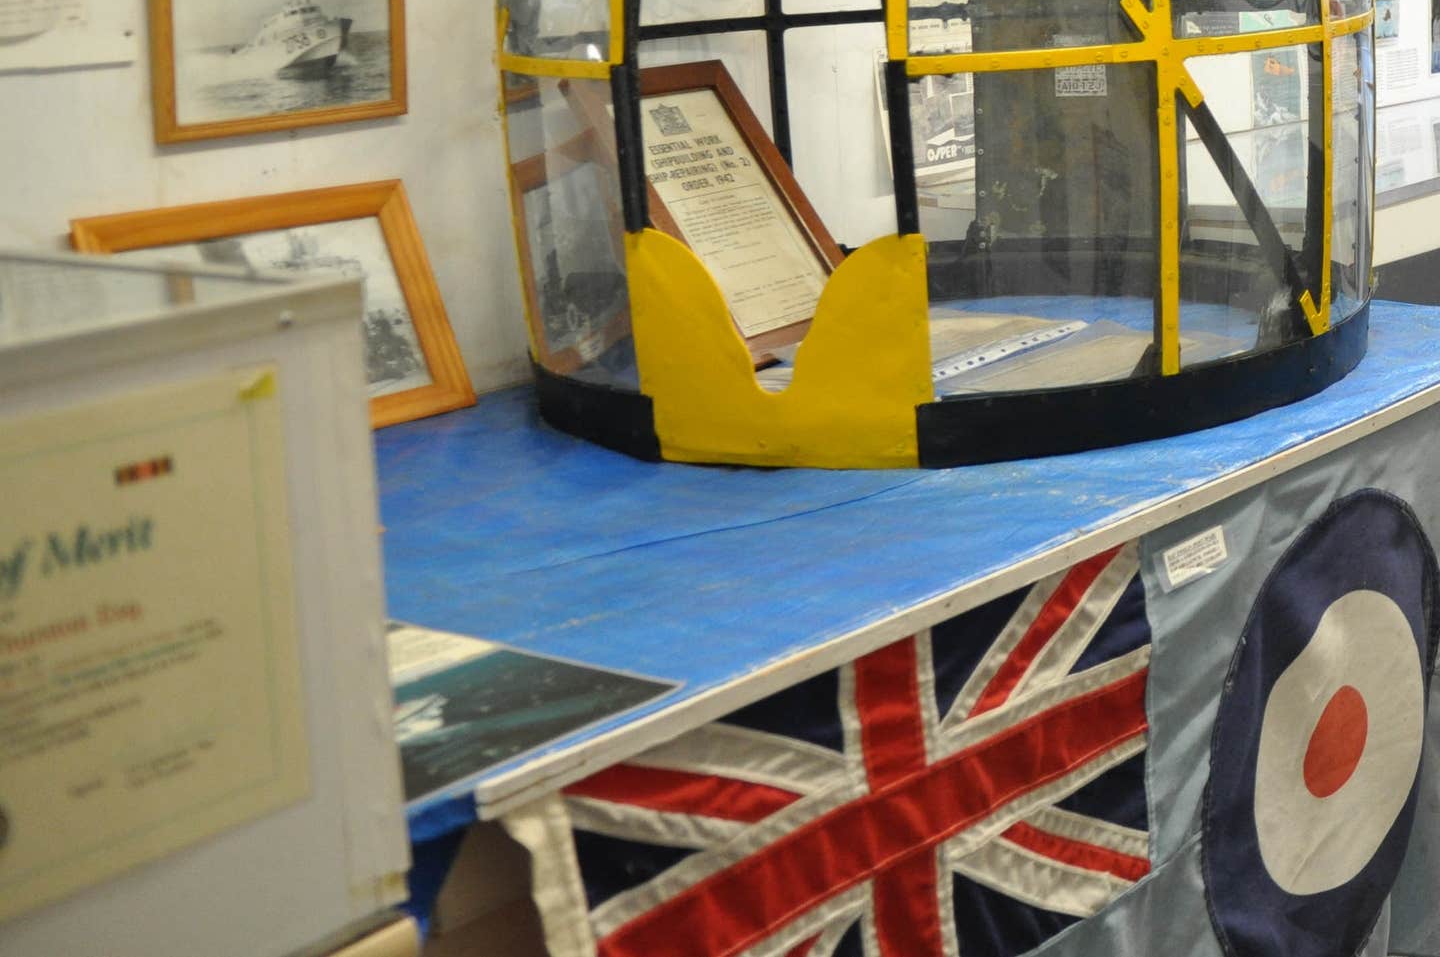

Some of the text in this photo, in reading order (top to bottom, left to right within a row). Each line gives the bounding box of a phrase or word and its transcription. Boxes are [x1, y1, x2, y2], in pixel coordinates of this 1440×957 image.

[648, 135, 722, 156] ESSENTIAL WORK
[651, 145, 734, 169] (SHIPBUILDING AND
[738, 155, 752, 167] 2)
[715, 172, 735, 185] 1942
